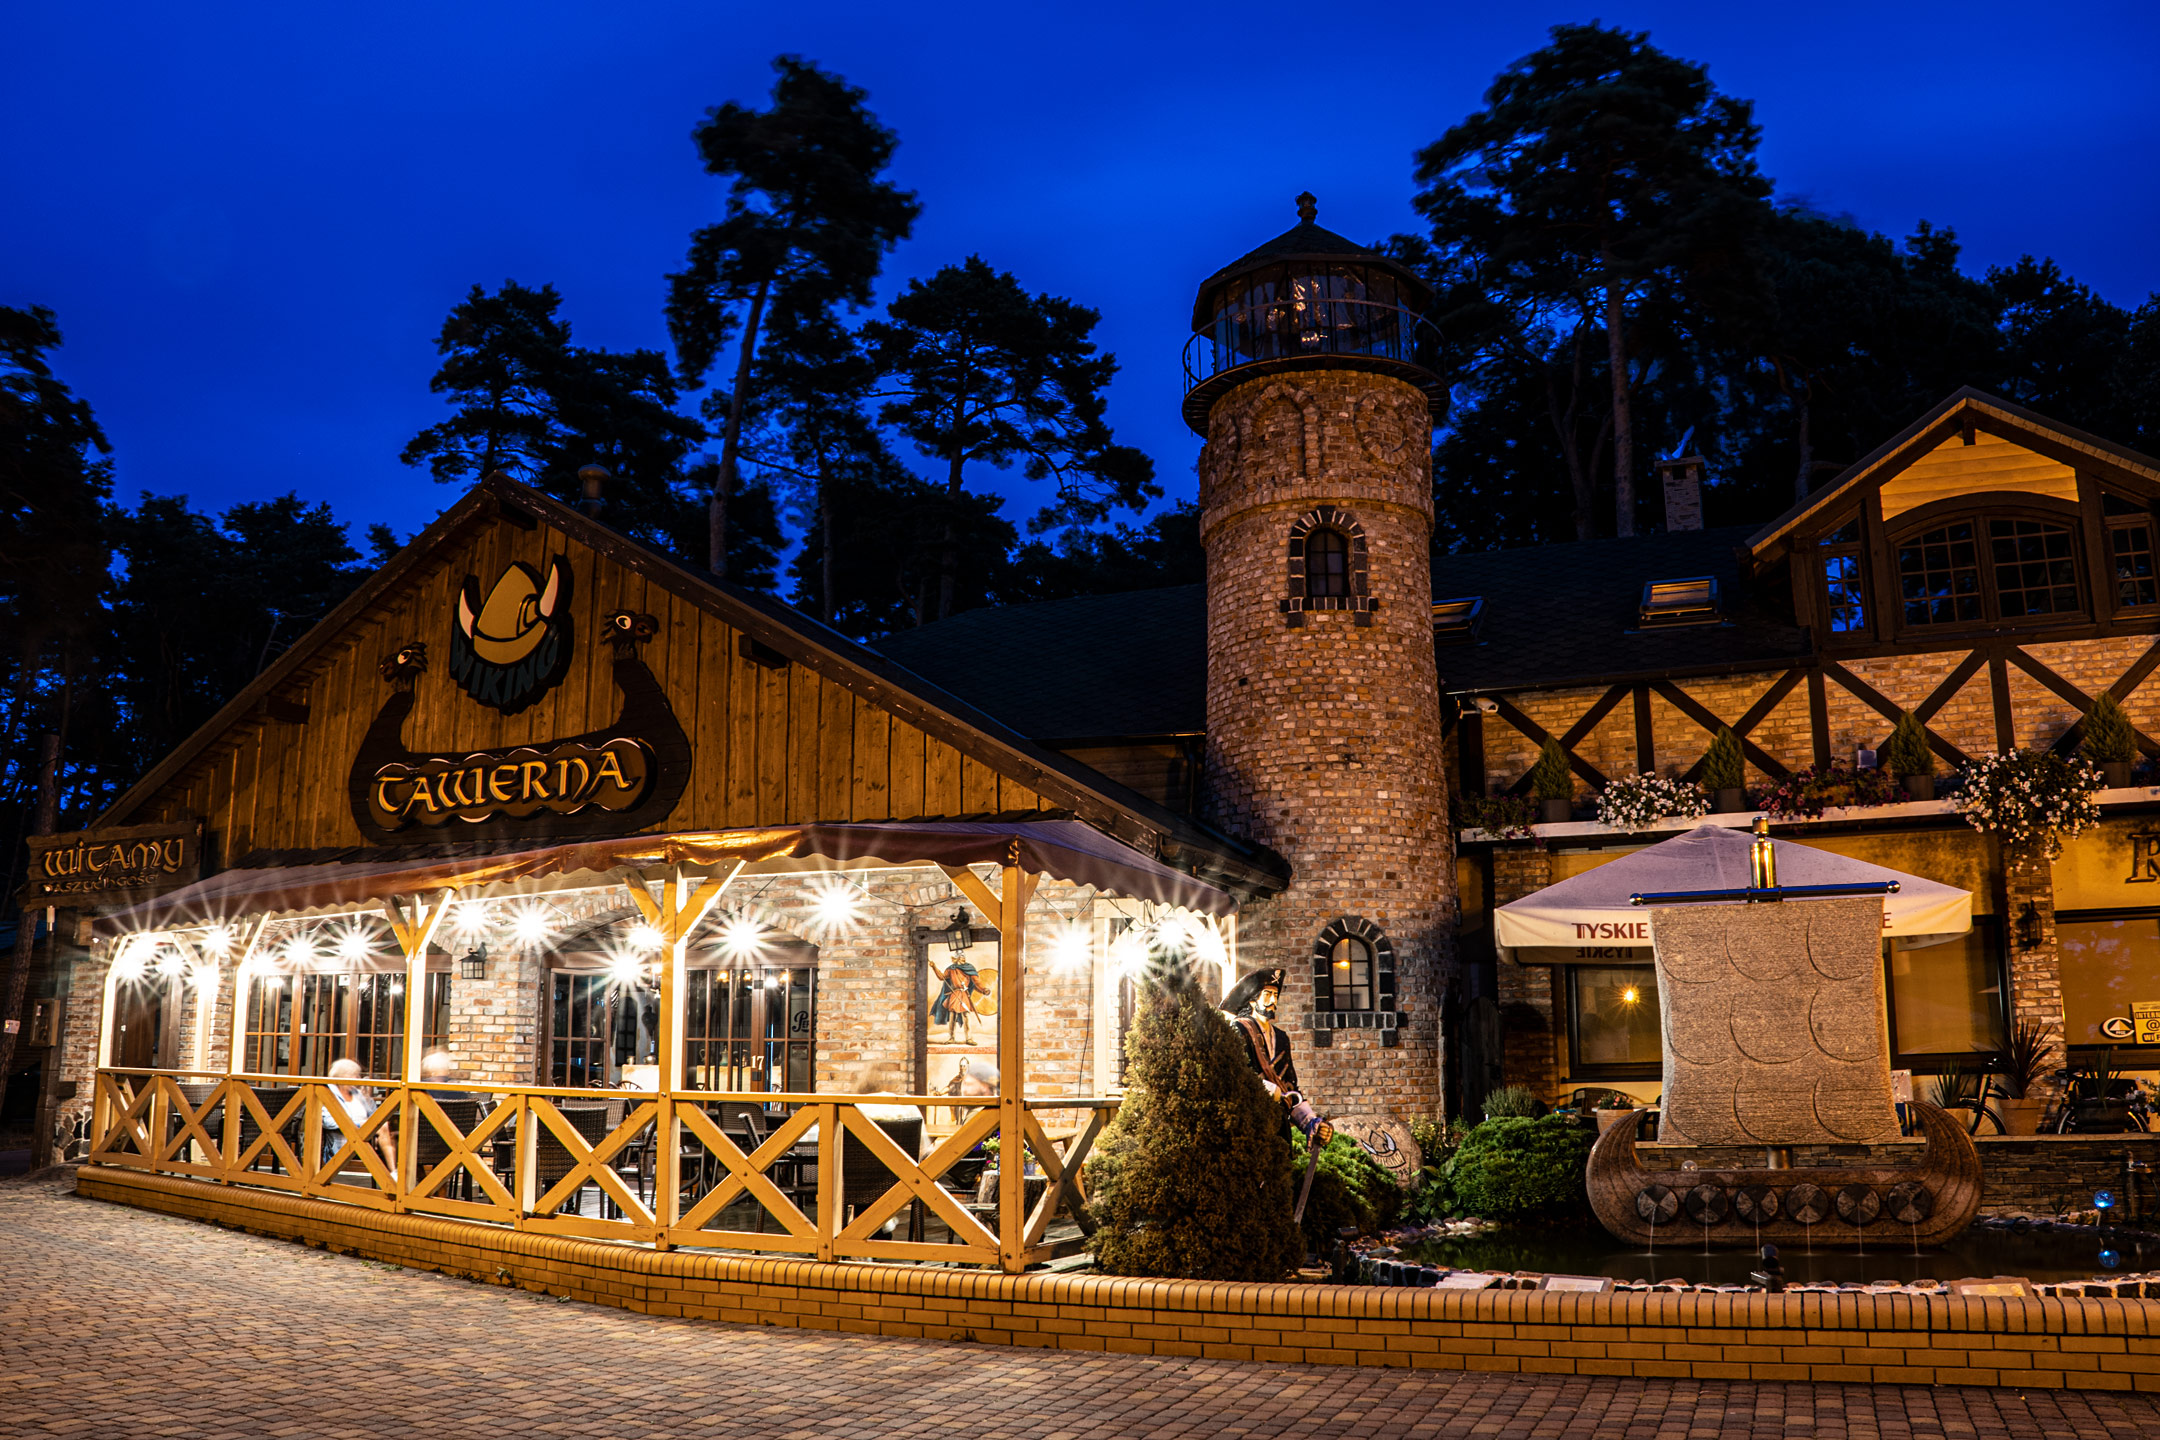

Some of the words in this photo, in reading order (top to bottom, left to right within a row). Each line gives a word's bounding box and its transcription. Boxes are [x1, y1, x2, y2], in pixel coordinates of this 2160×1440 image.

[451, 622, 559, 705] WIKING
[377, 750, 632, 817] TAWERNA
[44, 838, 184, 877] WITAMY
[1571, 922, 1649, 939] TYSKIE
[751, 1055, 765, 1071] 17
